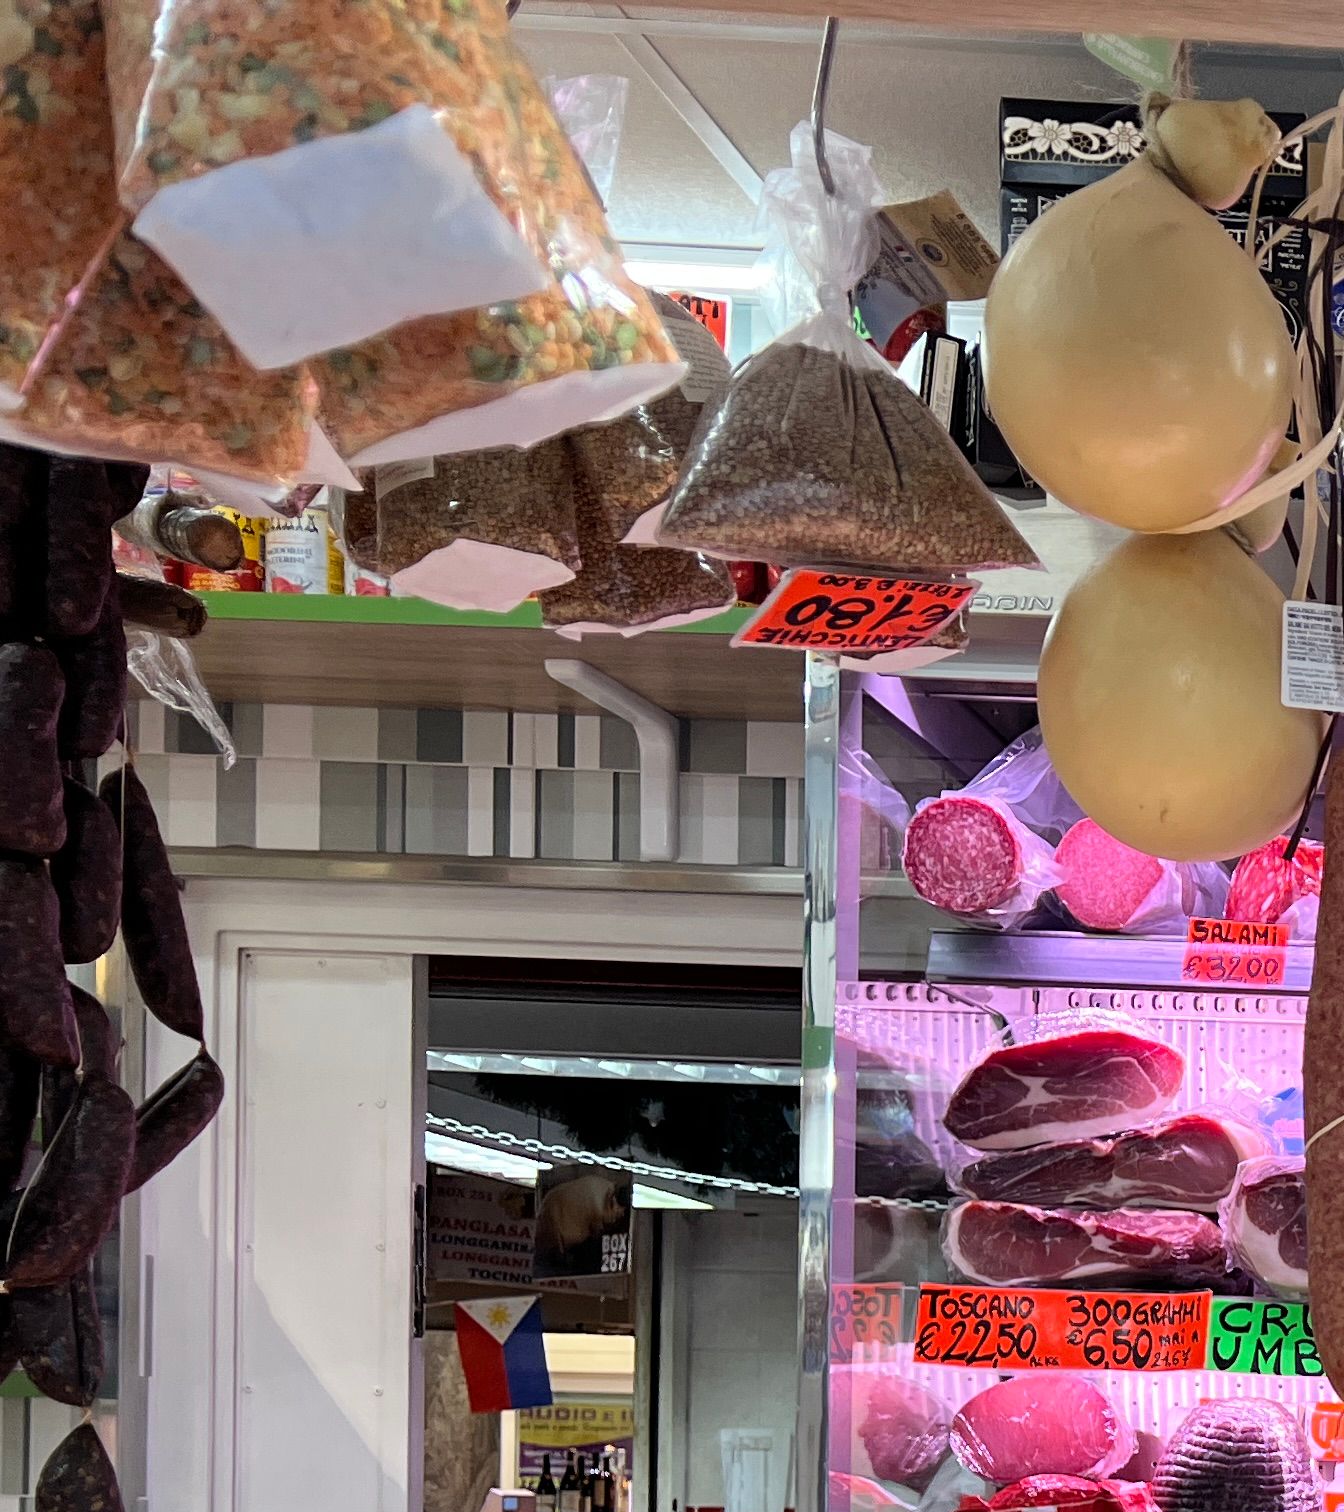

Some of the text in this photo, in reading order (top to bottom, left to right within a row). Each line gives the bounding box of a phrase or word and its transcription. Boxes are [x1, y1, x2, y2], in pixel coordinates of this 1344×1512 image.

[600, 1233, 628, 1253] BOX
[600, 1252, 627, 1273] 267
[920, 1289, 1035, 1320] TOSCANO
